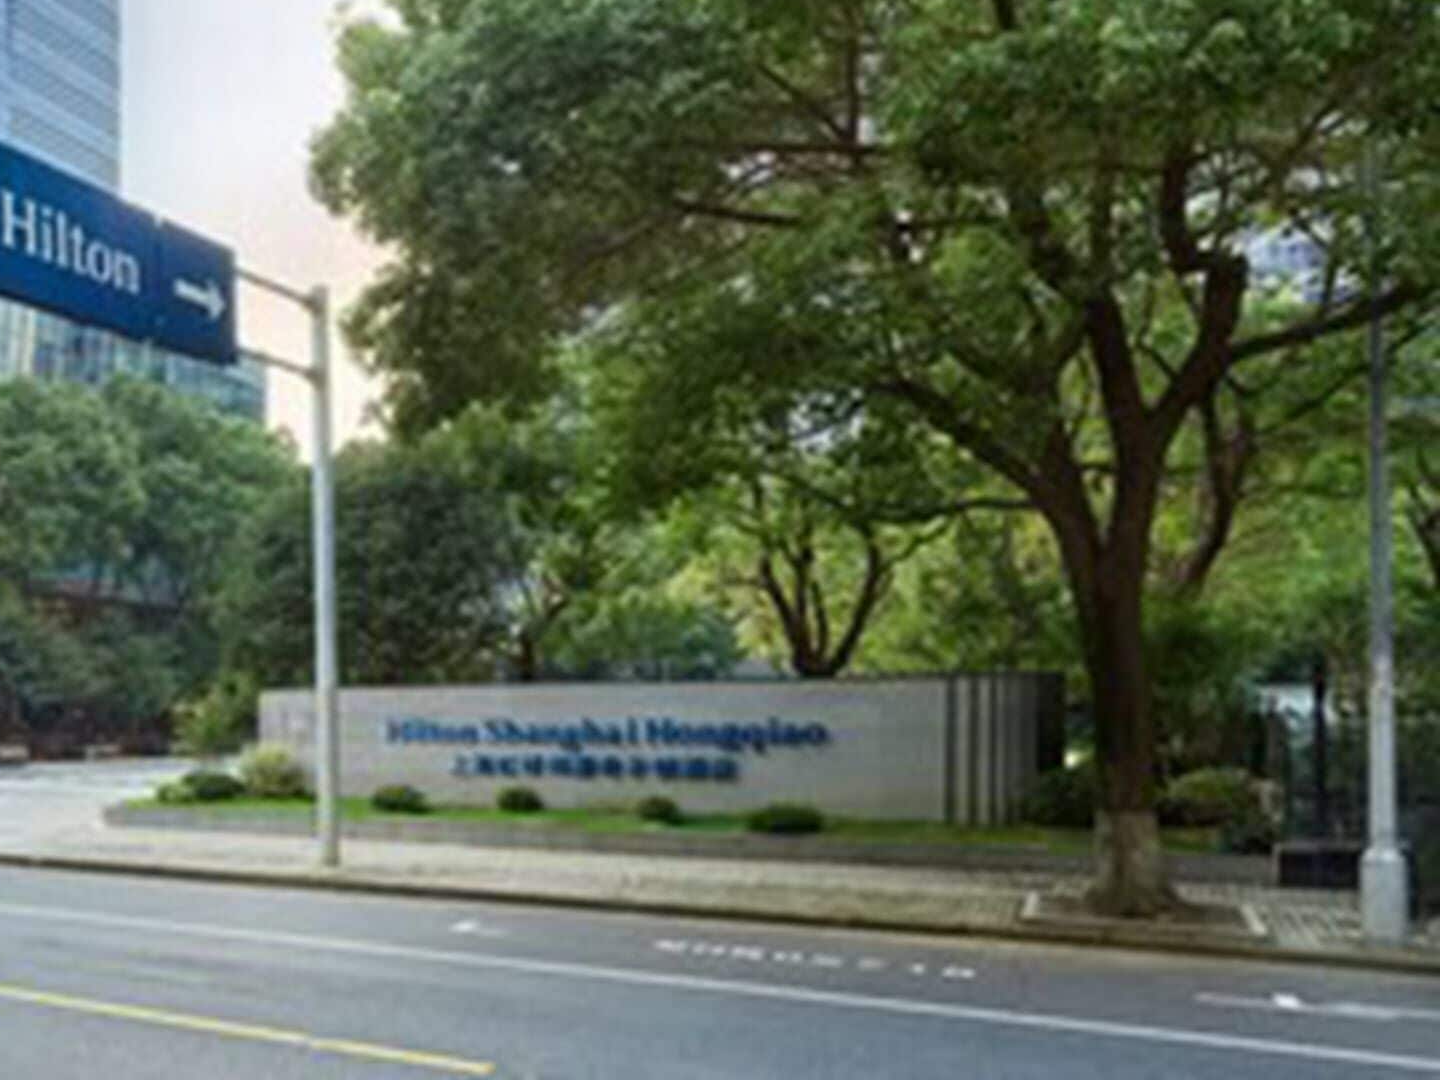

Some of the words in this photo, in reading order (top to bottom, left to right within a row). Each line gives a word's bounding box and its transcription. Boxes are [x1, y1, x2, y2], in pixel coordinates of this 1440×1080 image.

[0, 189, 140, 295] Hilton
[387, 718, 478, 743] Hilton
[484, 717, 639, 754] Shanghai
